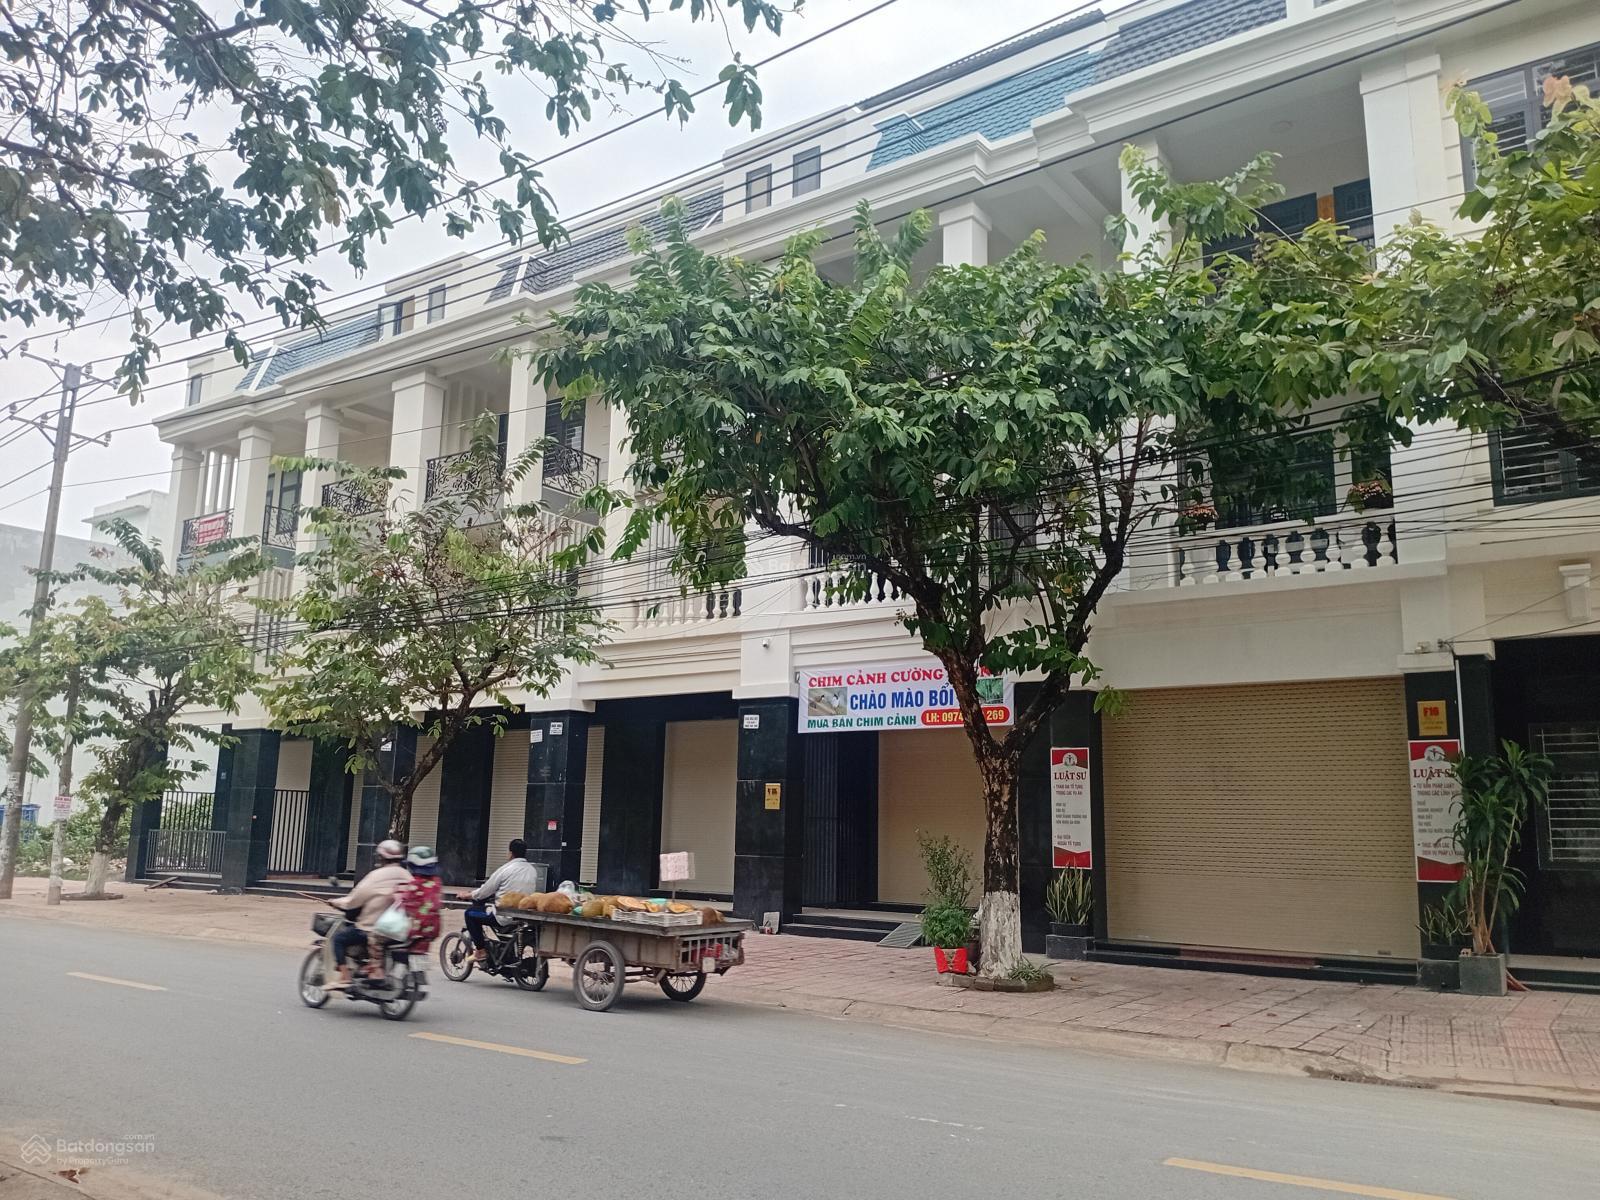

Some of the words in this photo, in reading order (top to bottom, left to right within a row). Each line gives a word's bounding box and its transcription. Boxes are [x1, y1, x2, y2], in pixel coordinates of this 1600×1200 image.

[809, 676, 842, 687] CHIM
[846, 670, 887, 685] CẢNH
[891, 667, 944, 682] CƯỜNG
[850, 689, 887, 710] CHÀO
[891, 688, 924, 708] MÀO
[929, 682, 954, 706] BỔI
[807, 719, 829, 728] MUA
[832, 716, 853, 727] BÁN
[856, 717, 884, 727] CHIM
[887, 712, 917, 726] CẢNH
[926, 712, 940, 723] LH:
[986, 709, 1005, 720] 269
[1054, 770, 1075, 782] LUẬT
[1076, 770, 1087, 780] SƯ
